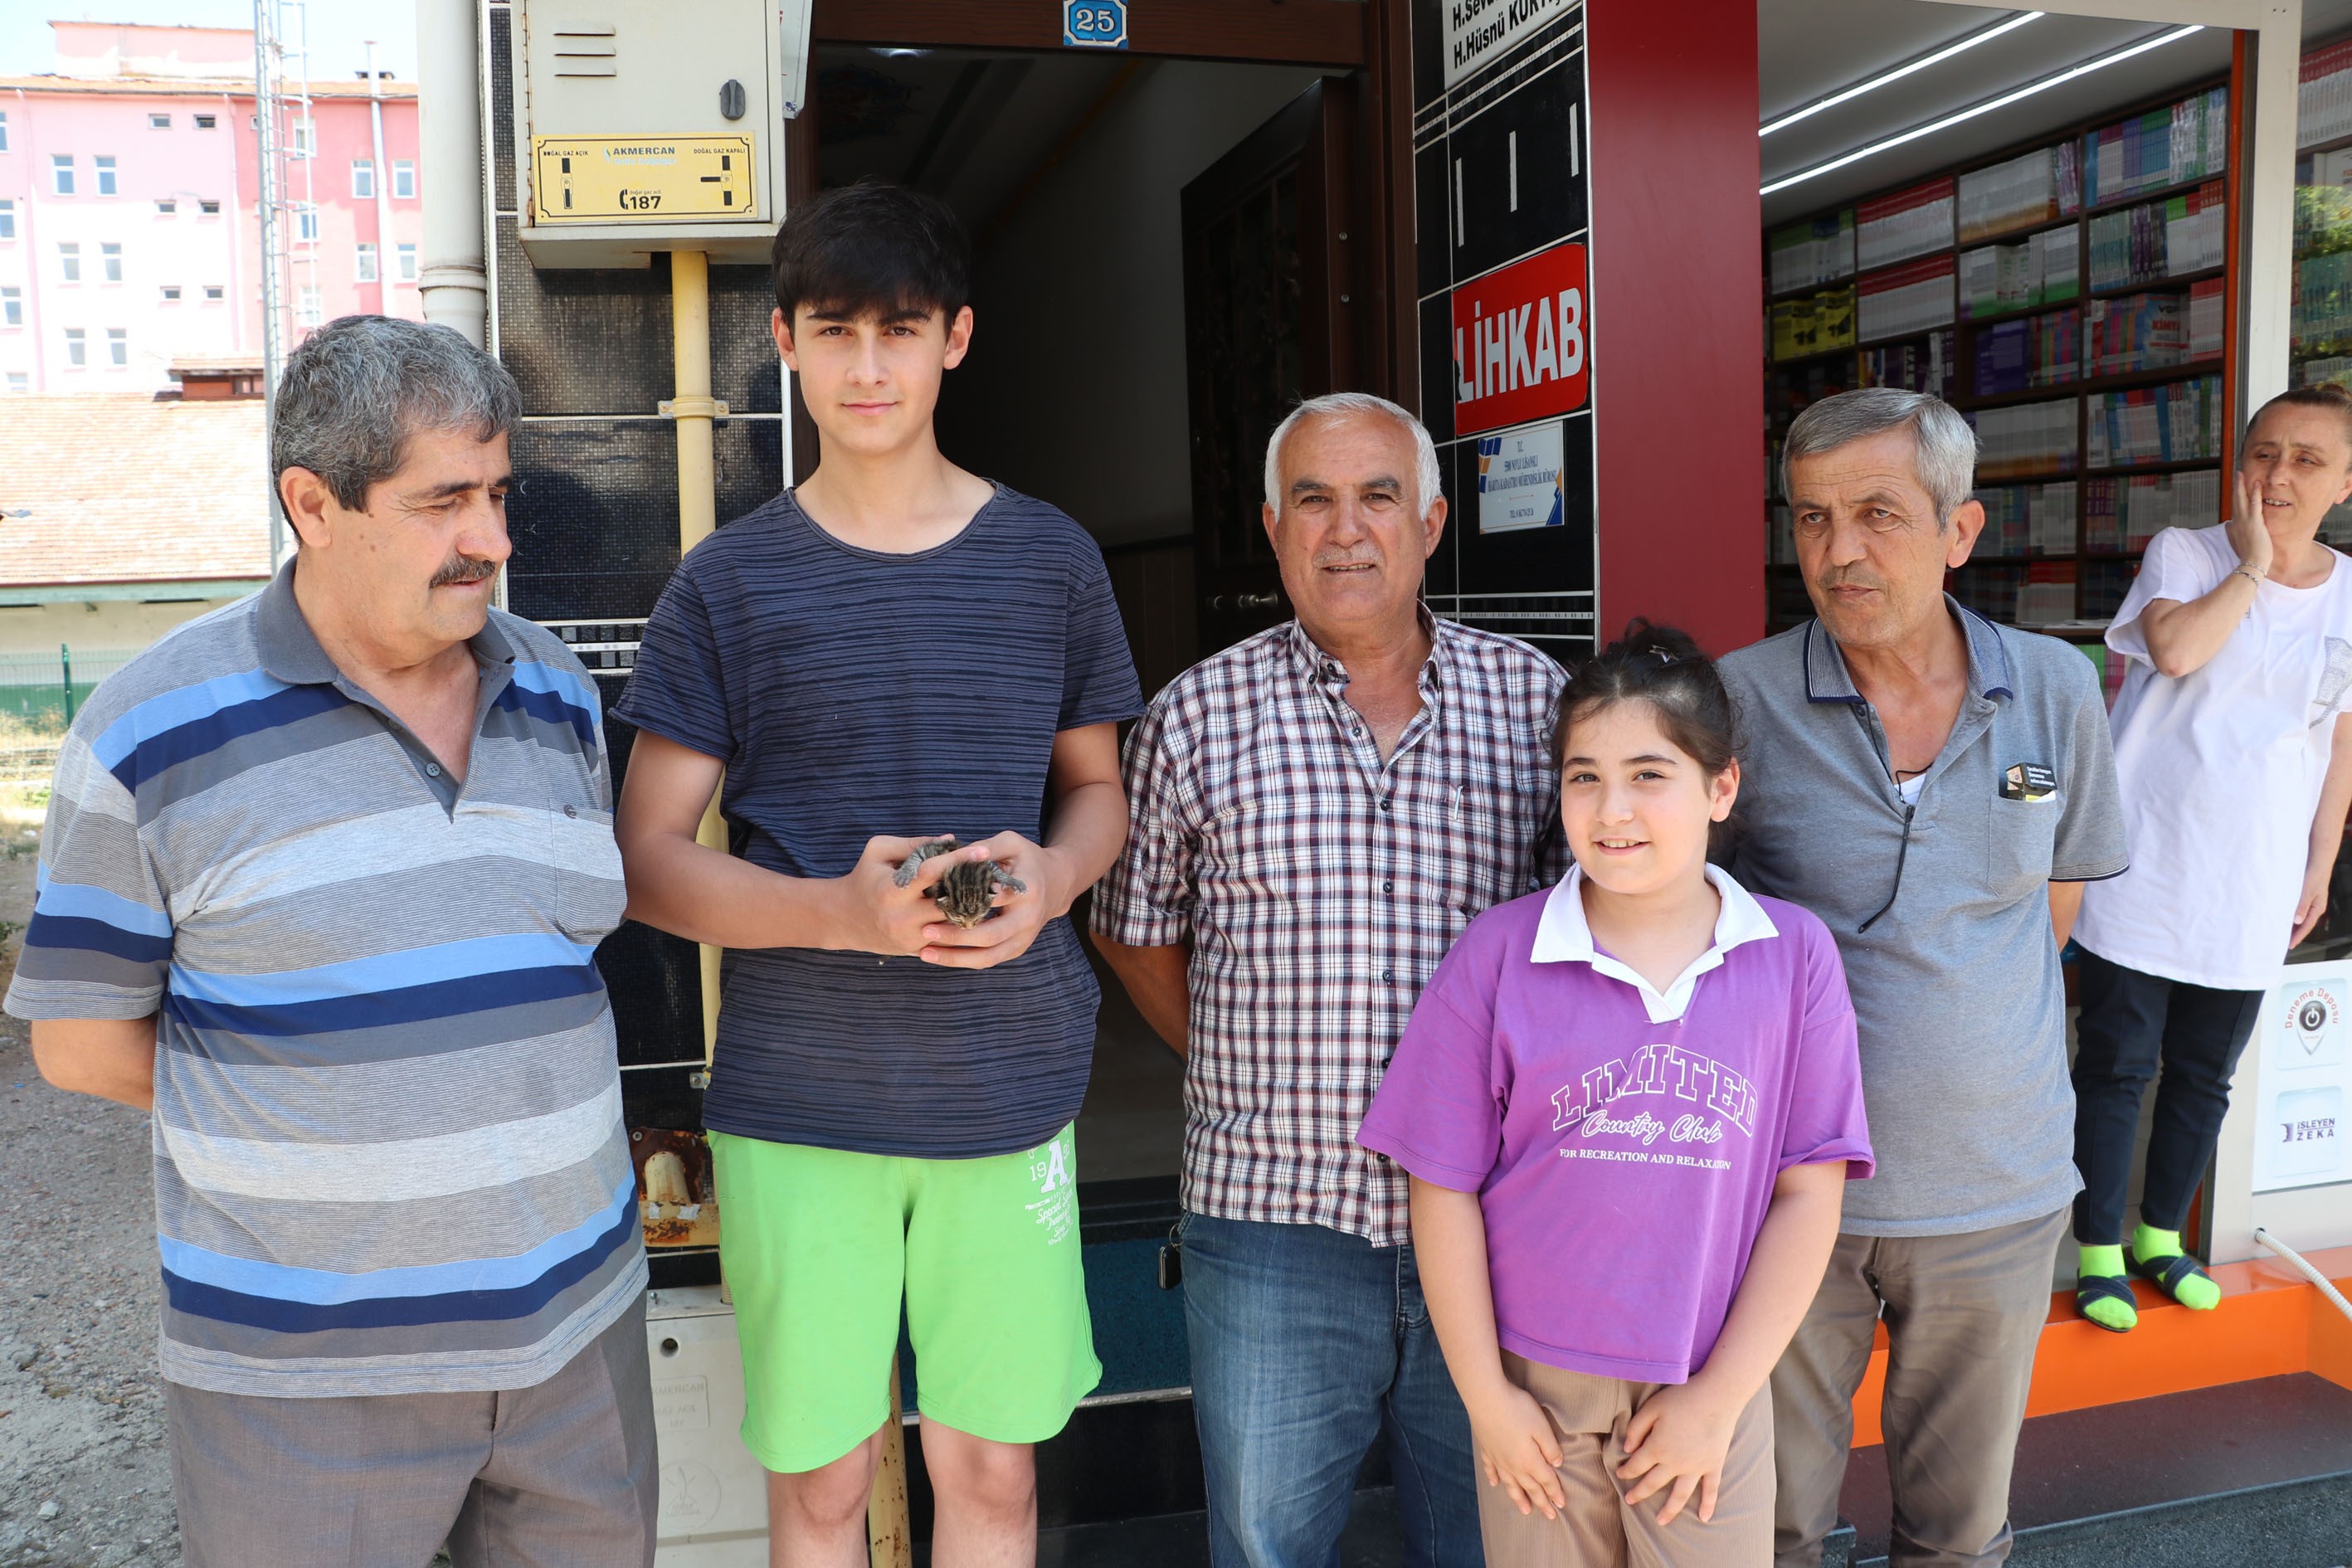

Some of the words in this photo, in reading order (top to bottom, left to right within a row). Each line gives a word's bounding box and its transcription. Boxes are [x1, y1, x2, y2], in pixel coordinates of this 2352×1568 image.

[1076, 8, 1115, 32] 25
[1453, 0, 1497, 32] H.Sev
[1454, 10, 1505, 69] H.Hüsnü
[613, 147, 675, 155] AKMERCAN
[630, 196, 662, 209] 187
[1456, 287, 1585, 405] LİHKAB
[2285, 990, 2315, 1029] Deneme
[2317, 987, 2339, 1024] Deposu
[1551, 1044, 1758, 1137] LIMITED
[1581, 1109, 1665, 1146] Country
[1669, 1113, 1723, 1144] Club
[2296, 1128, 2335, 1142] ZEKA
[1030, 1161, 1047, 1181] 19
[1041, 1140, 1069, 1193] A
[1560, 1148, 1577, 1158] FOR
[1580, 1149, 1649, 1162] RECREATION
[1650, 1153, 1674, 1164] AND
